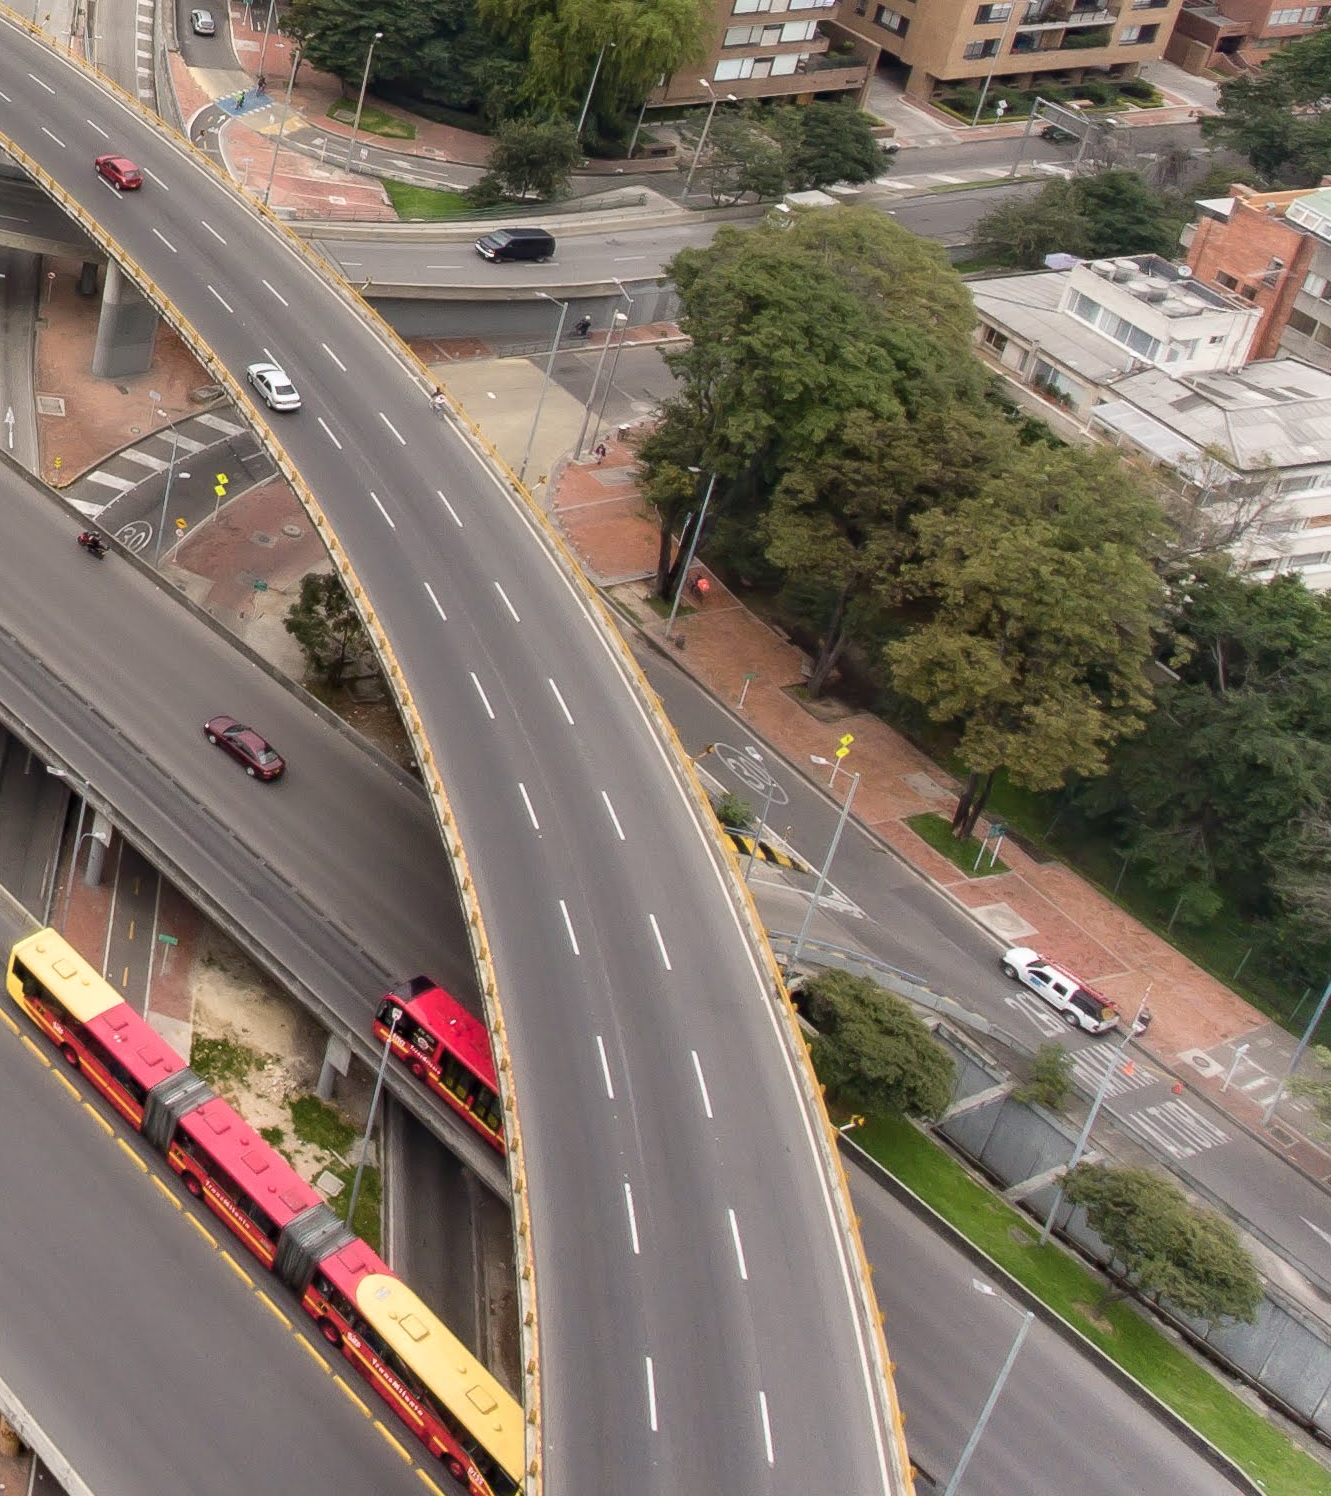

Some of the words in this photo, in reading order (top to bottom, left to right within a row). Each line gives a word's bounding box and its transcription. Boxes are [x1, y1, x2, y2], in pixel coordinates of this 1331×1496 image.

[123, 527, 146, 550] 30
[727, 756, 772, 790] 30
[1130, 1098, 1233, 1159] ALTURA
